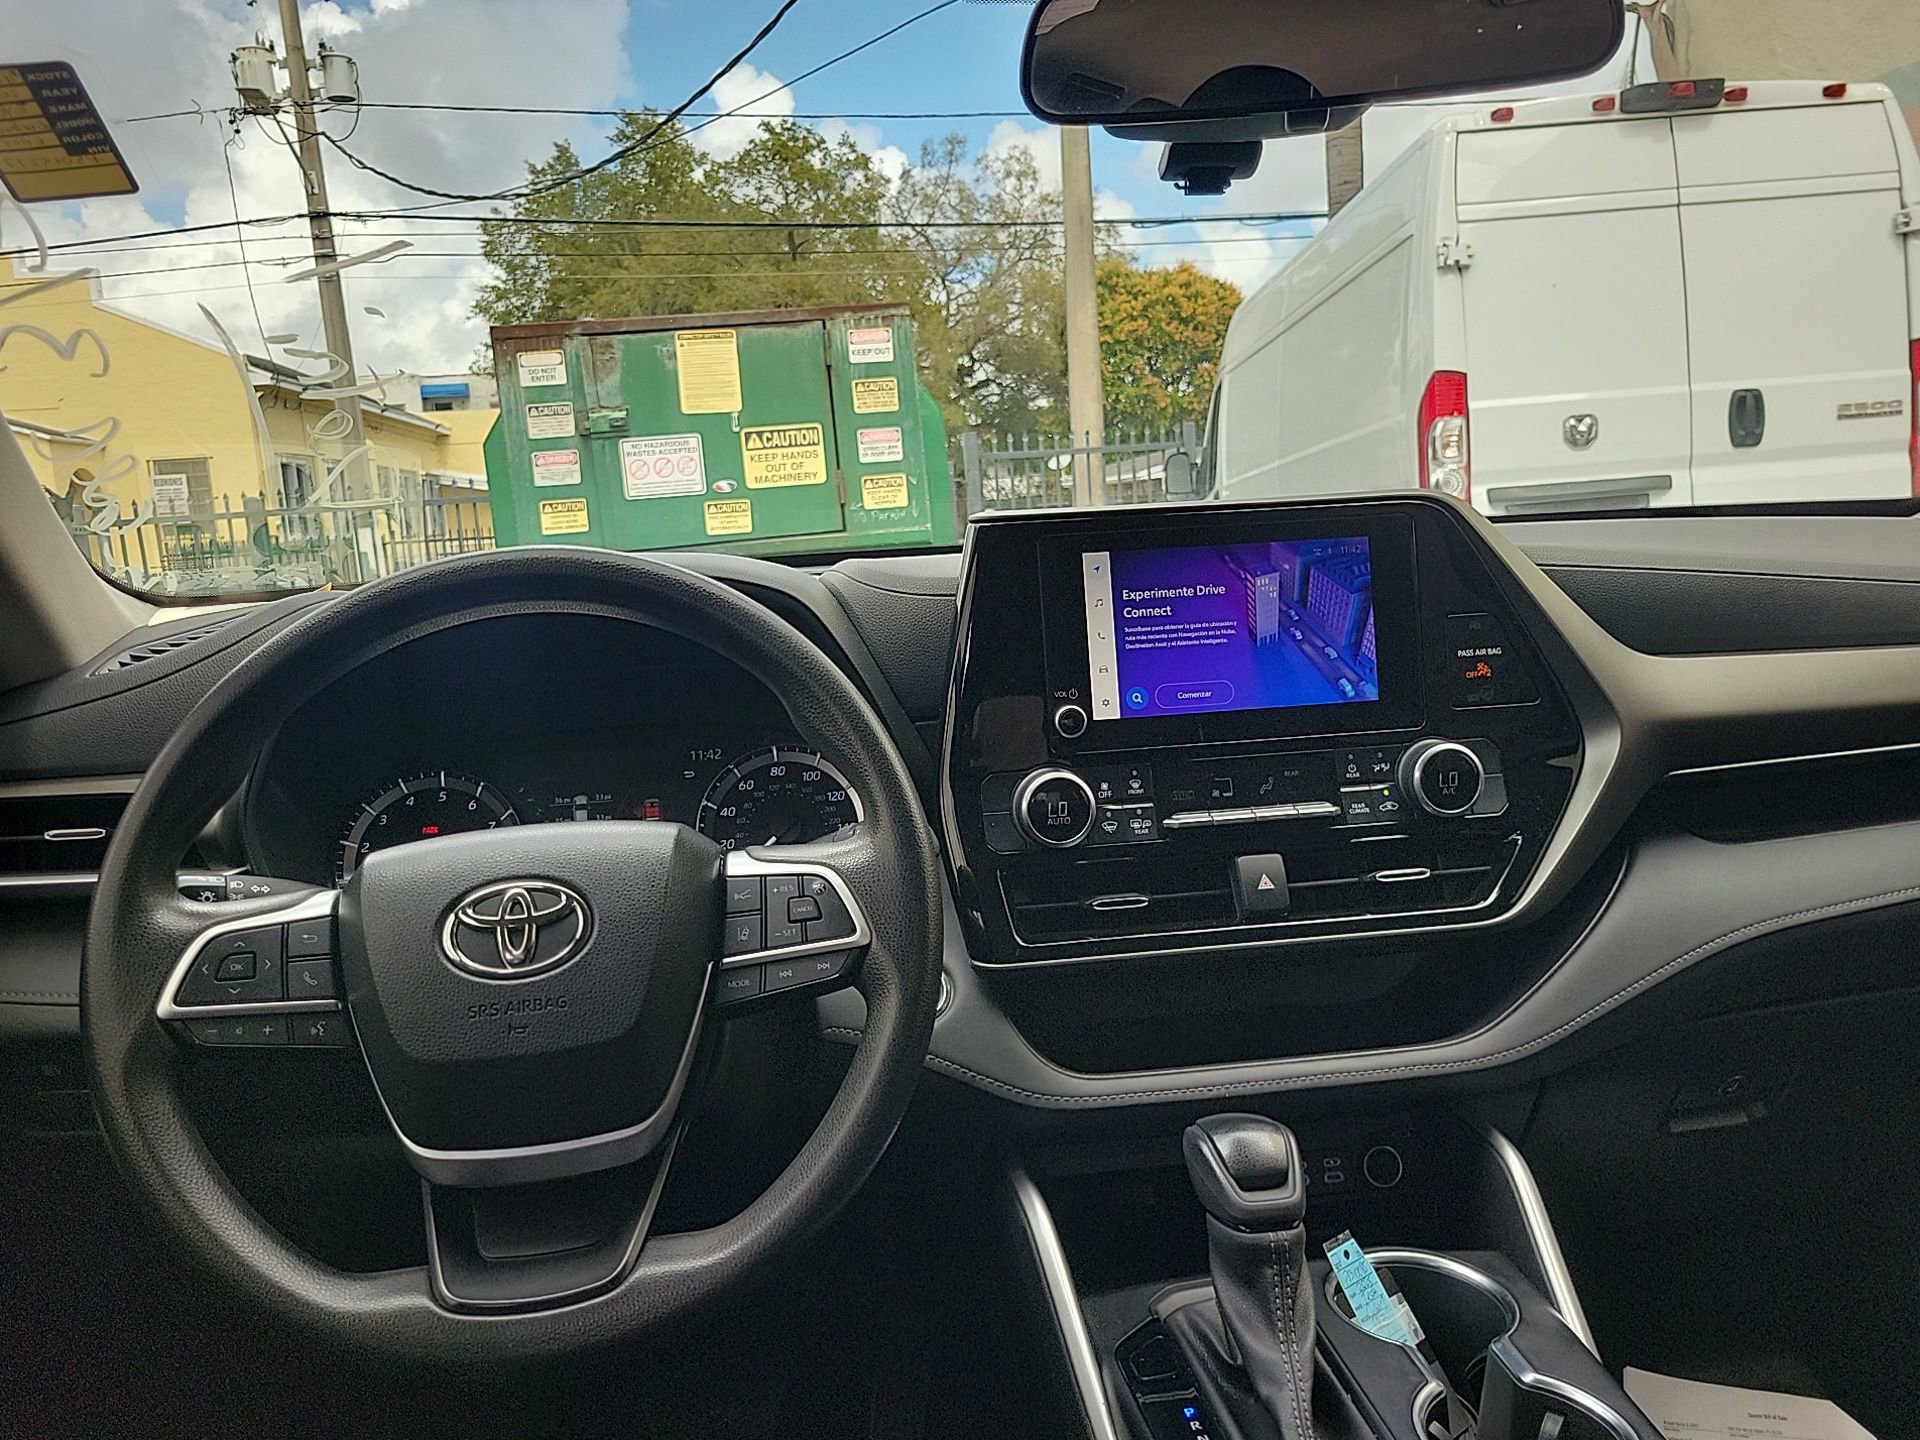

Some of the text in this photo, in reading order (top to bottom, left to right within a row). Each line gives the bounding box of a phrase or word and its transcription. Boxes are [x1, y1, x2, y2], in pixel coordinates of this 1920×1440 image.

[528, 368, 540, 376] DO
[531, 374, 556, 382] ENTER
[864, 381, 895, 390] CAUTION
[538, 406, 570, 416] CAUTION
[762, 428, 819, 448] CAUTION
[644, 440, 690, 449] HAZARDOUS
[626, 447, 698, 457] WASTES ACCEPTED
[750, 450, 819, 463] KEEP HANDS
[765, 462, 805, 472] OUT OF
[754, 471, 818, 485] MACHINERY
[552, 502, 584, 512] CAUTION
[717, 503, 748, 513] CAUTION
[1340, 545, 1361, 554] 11:42
[1123, 584, 1226, 601] Experimente Drive
[1123, 606, 1172, 618] Connect
[1475, 648, 1487, 656] AIR
[1487, 647, 1502, 655] BAG
[1178, 690, 1212, 699] Comenzar
[690, 748, 722, 761] 11:42
[770, 766, 786, 776] 80
[801, 771, 821, 781] 100
[738, 780, 754, 790] 60
[438, 791, 447, 802] 5
[826, 791, 845, 801] 120
[1098, 791, 1113, 799] OFF
[405, 796, 414, 806] 4
[468, 799, 477, 810] 6
[720, 806, 736, 817] 40
[1048, 801, 1068, 818] LO
[379, 814, 387, 825] 3
[1047, 817, 1071, 825] AUTO
[487, 822, 496, 830] 7
[361, 842, 370, 853] 2
[720, 839, 735, 850] 20
[230, 963, 244, 971] OK
[728, 980, 750, 988] MODE
[467, 996, 568, 1019] SRS AIRBAG
[1184, 1407, 1194, 1418] P
[1190, 1421, 1203, 1431] R
